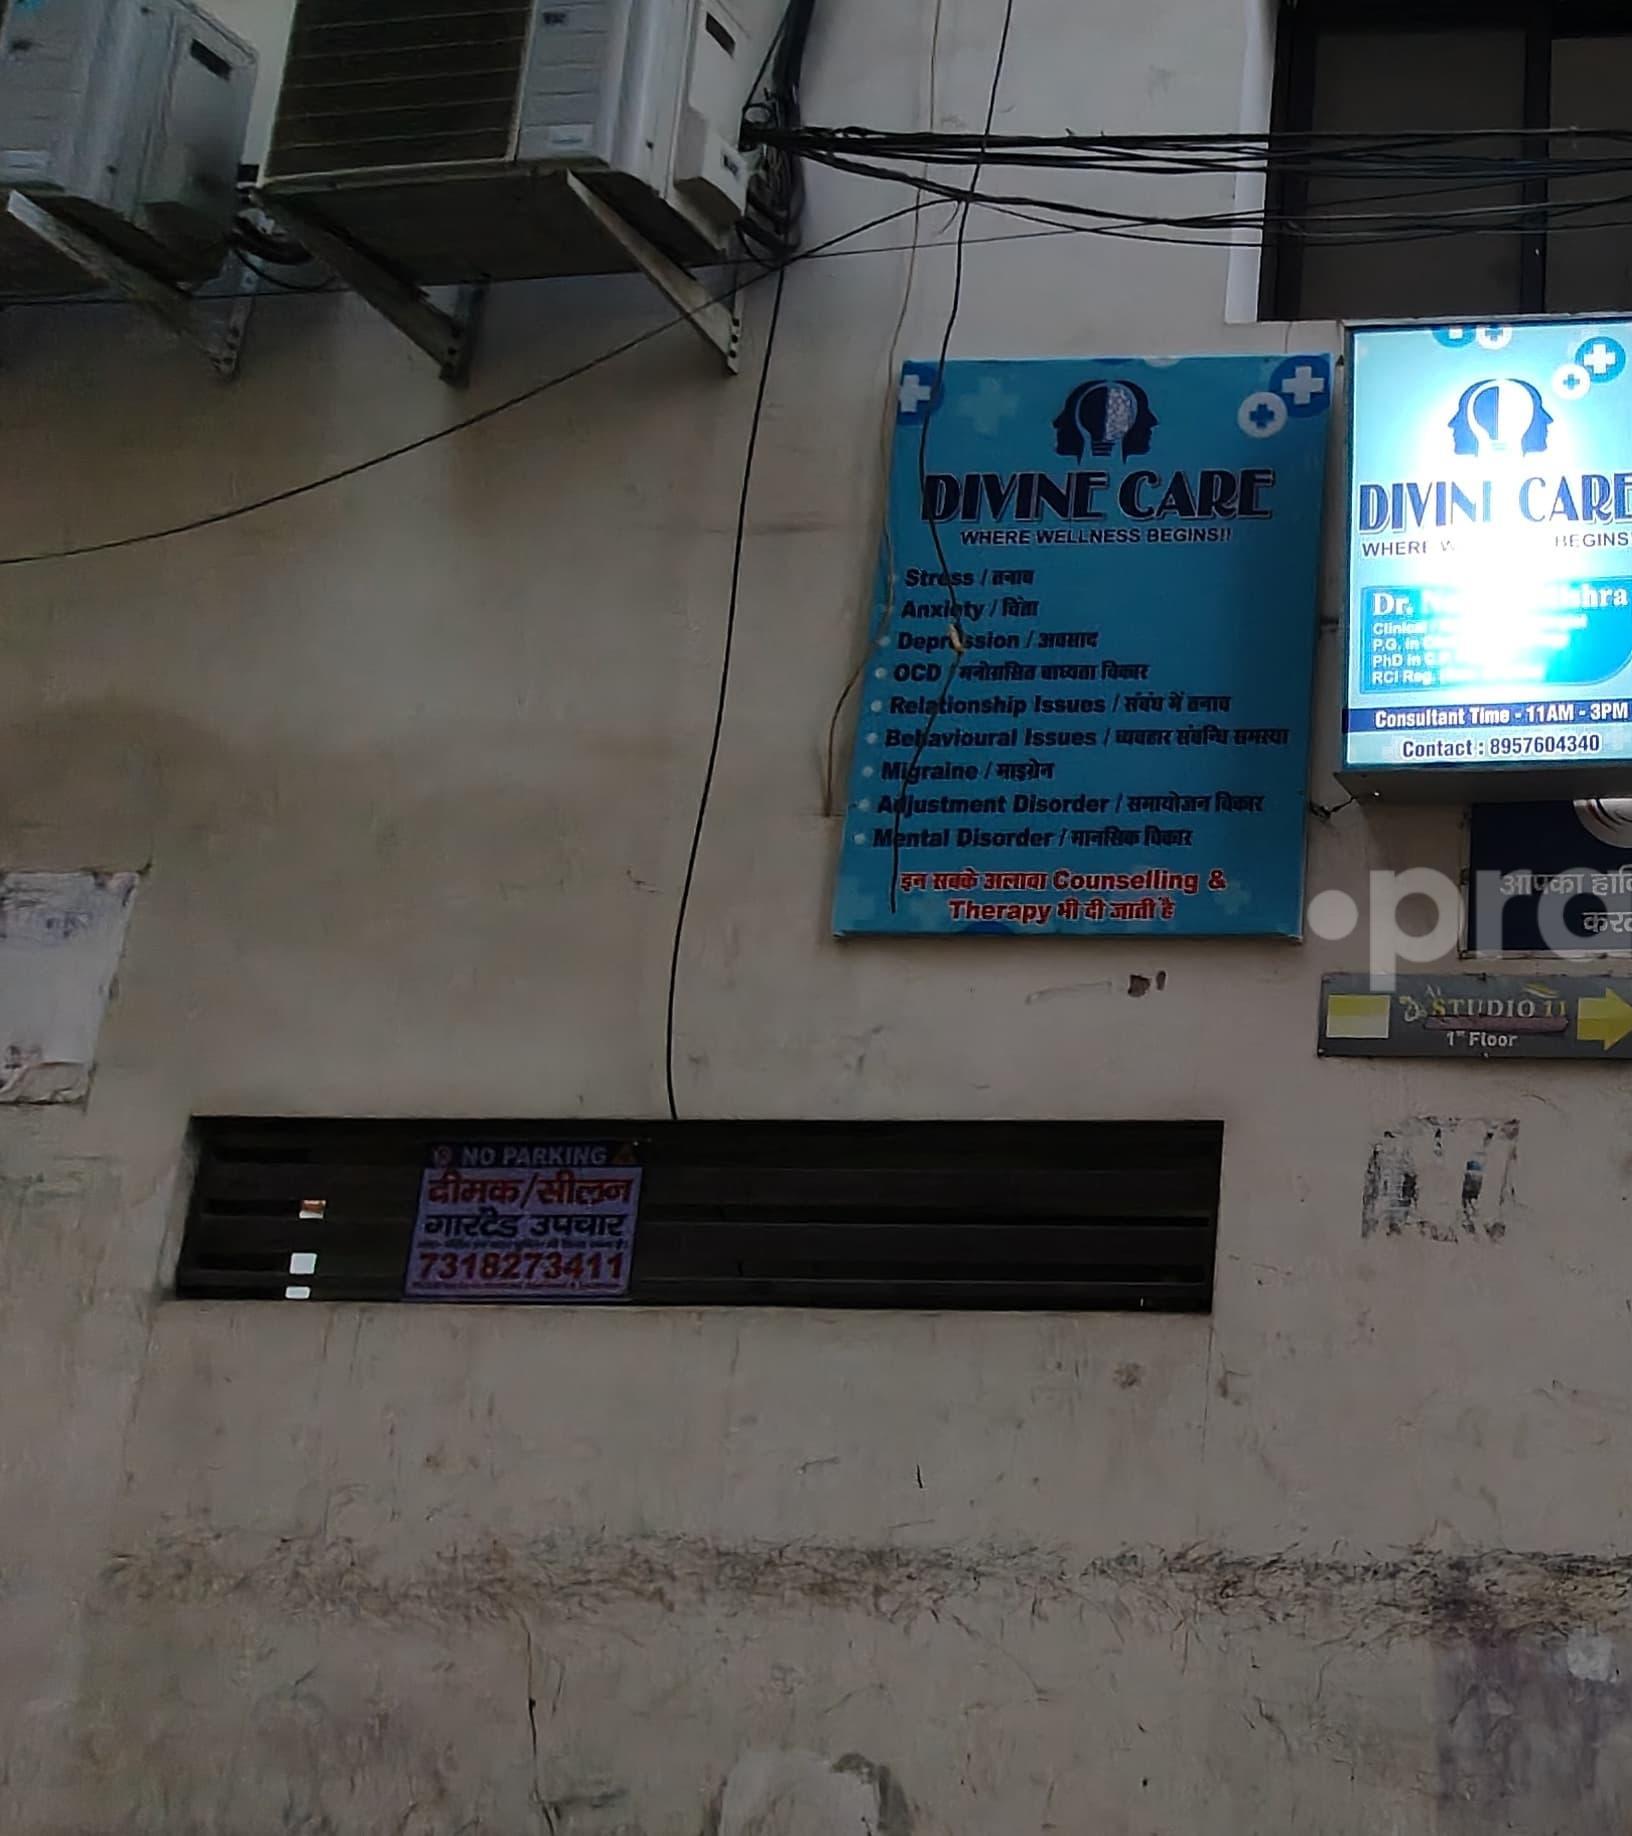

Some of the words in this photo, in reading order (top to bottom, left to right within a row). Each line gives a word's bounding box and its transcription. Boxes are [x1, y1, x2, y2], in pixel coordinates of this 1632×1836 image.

[921, 470, 1110, 522] DIVINE
[1117, 468, 1275, 520] CARE
[960, 529, 1030, 546] WHERE
[1036, 527, 1141, 545] WELLNESS
[1147, 526, 1232, 544] BEGINS!!
[904, 568, 974, 587] Stress
[1372, 592, 1414, 616] Dr.
[897, 631, 1019, 654] Deprssion
[894, 663, 941, 681] OCD
[1371, 653, 1404, 669] PhD
[1371, 670, 1399, 685] RCI
[890, 695, 1028, 717] Relationship
[1035, 696, 1106, 713] Issues
[1375, 709, 1466, 728] Consultant
[1469, 706, 1510, 725] Time
[1526, 703, 1575, 722] 11AM
[1590, 702, 1629, 720] 3PM
[885, 728, 1018, 746] Behavioural
[1024, 728, 1096, 746] Issues
[1403, 740, 1472, 757] Contact
[1490, 734, 1600, 754] 8957604340
[881, 761, 978, 783] Migraine
[877, 795, 1006, 817] Adjustment
[1013, 794, 1110, 814] Disorder
[872, 828, 949, 848] Mental
[956, 828, 1053, 848] Disorder
[901, 873, 928, 891] इन
[1053, 869, 1199, 894] Counselling
[1208, 869, 1227, 890] &
[1499, 873, 1584, 896] आपका
[950, 899, 1051, 924] Therapy
[1110, 897, 1155, 920] जाती
[1431, 998, 1536, 1018] STUDIO
[1468, 1031, 1519, 1047] Floor
[461, 1145, 497, 1167] NO
[502, 1143, 610, 1167] PARKING
[530, 1213, 627, 1237] उपचार
[419, 1252, 625, 1280] 7318273411
